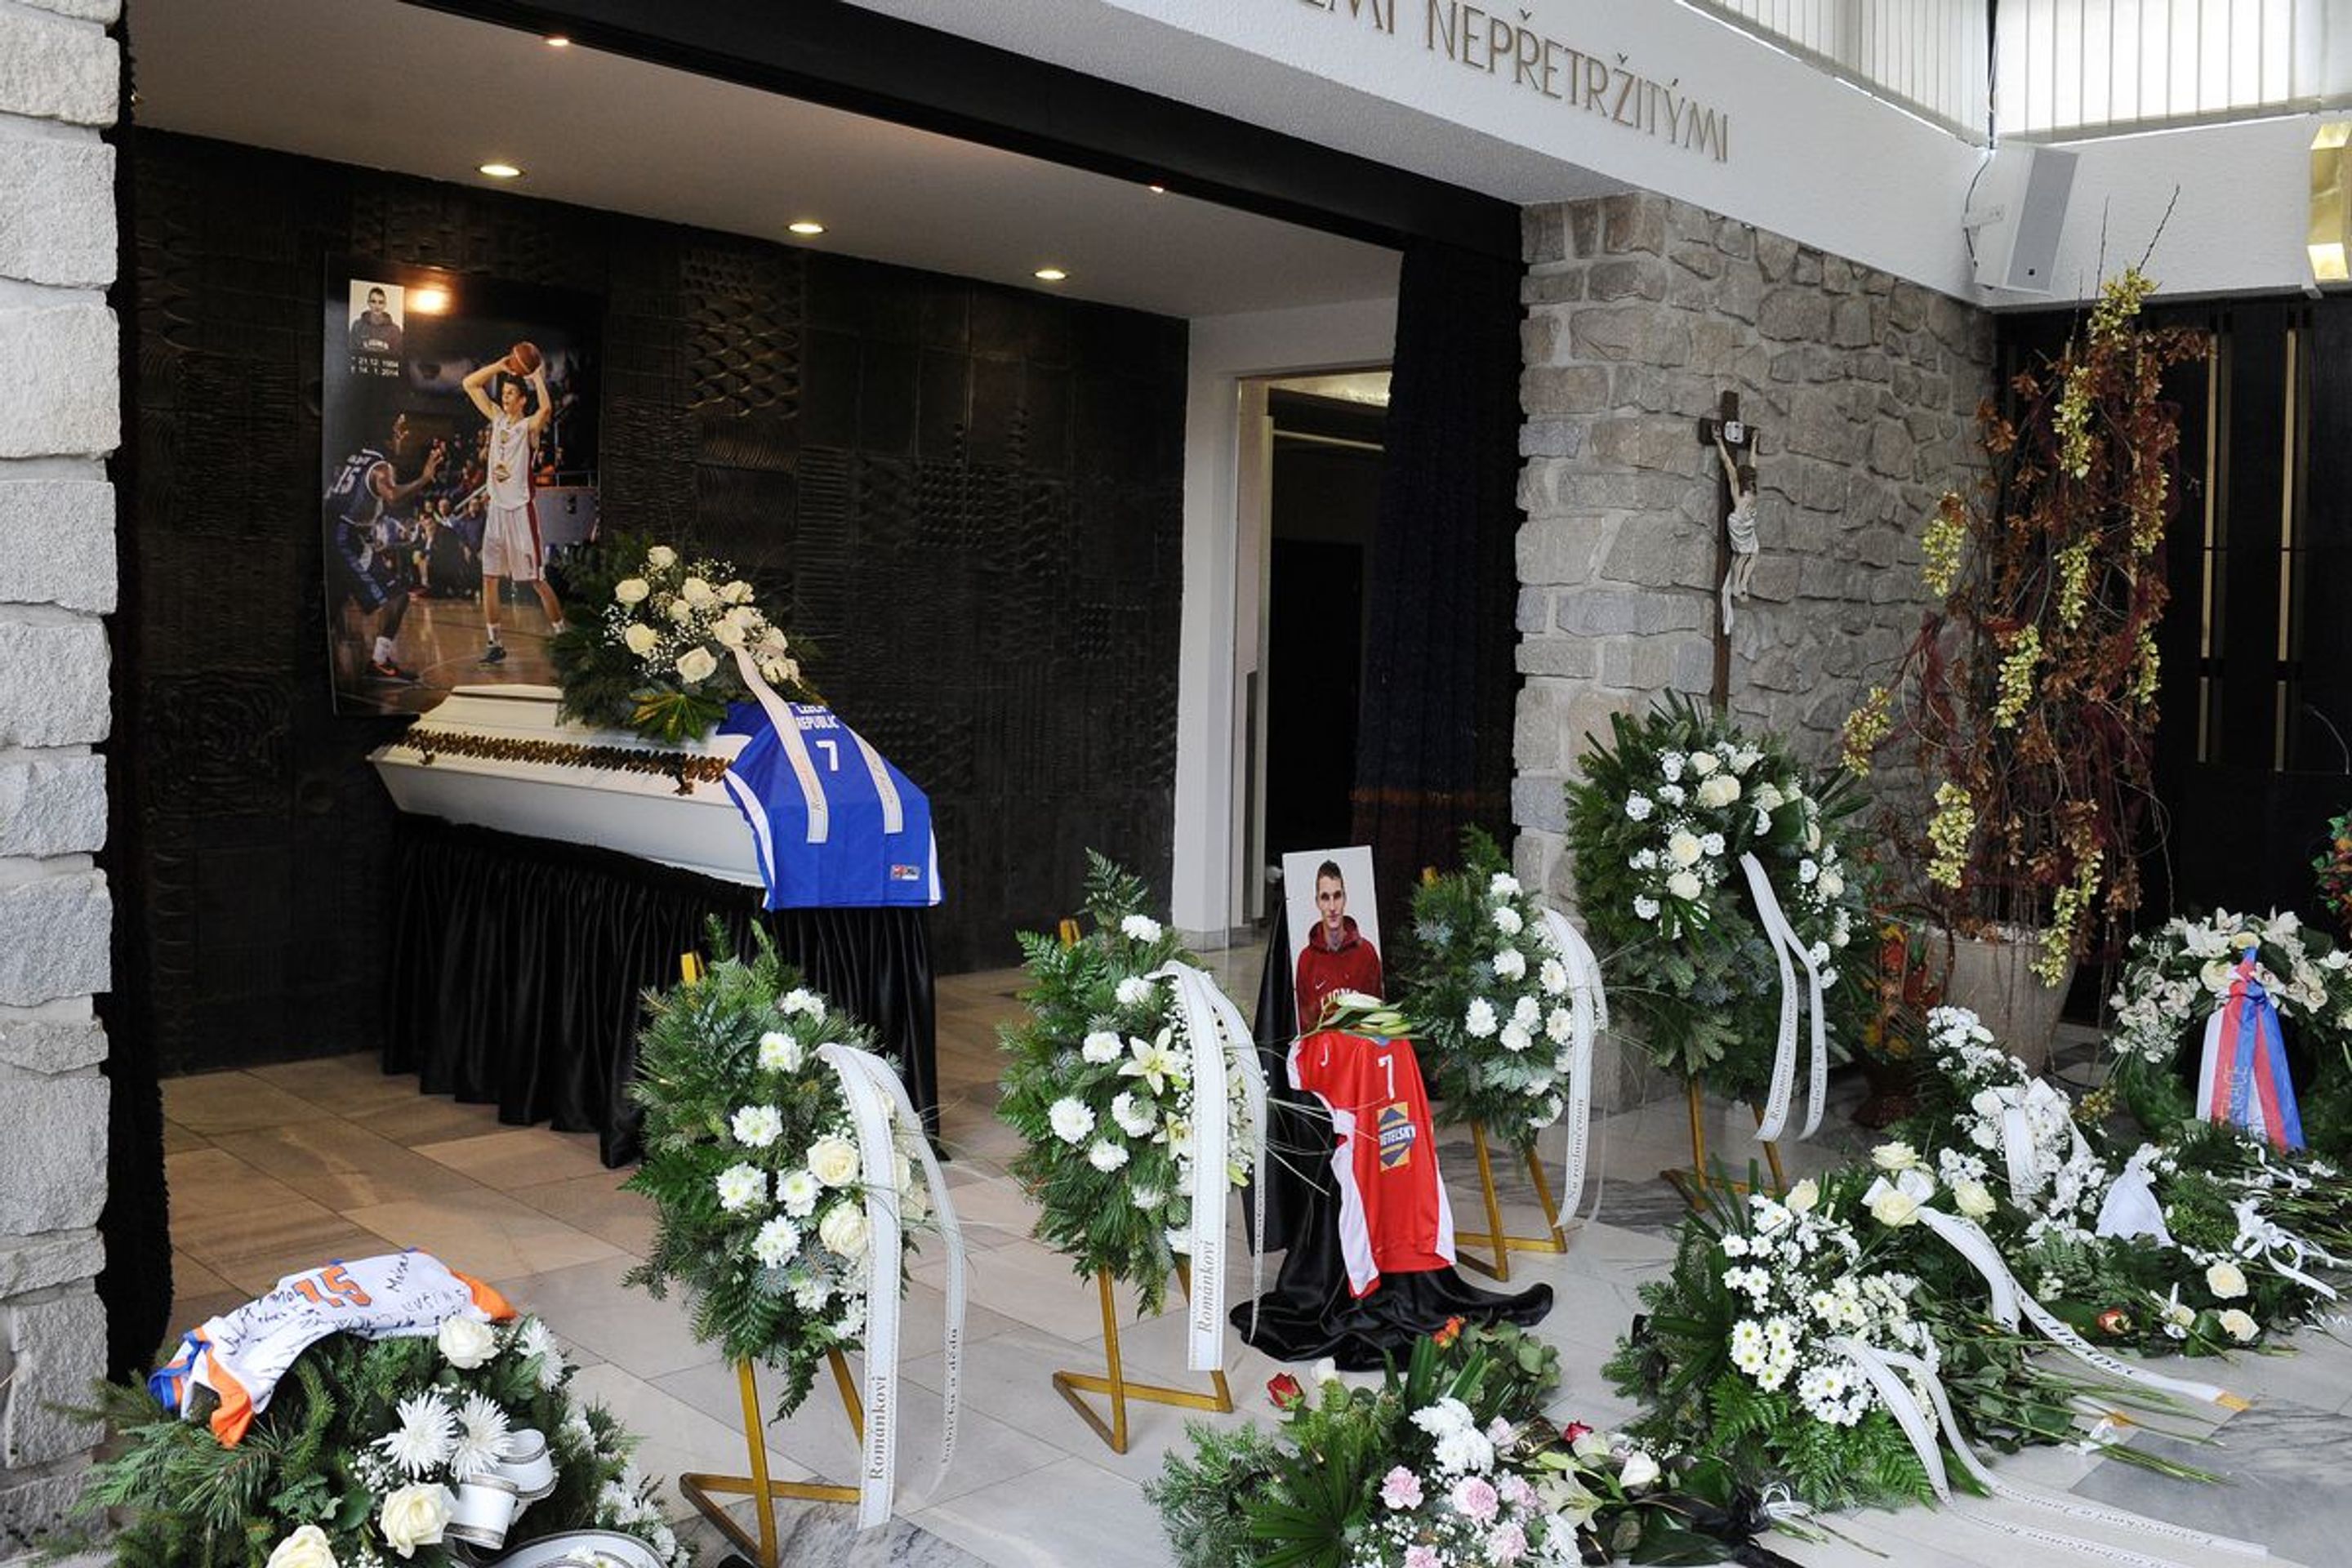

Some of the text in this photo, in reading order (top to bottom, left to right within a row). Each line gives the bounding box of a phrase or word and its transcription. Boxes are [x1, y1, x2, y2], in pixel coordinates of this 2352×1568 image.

[1428, 0, 1729, 163] NEPŘETRŽITÝMI
[815, 740, 839, 772] 7
[1377, 1054, 1396, 1100] 7
[292, 1265, 372, 1309] 15
[1196, 1240, 1214, 1334] Románkovi
[868, 1374, 888, 1480] Románkovi
